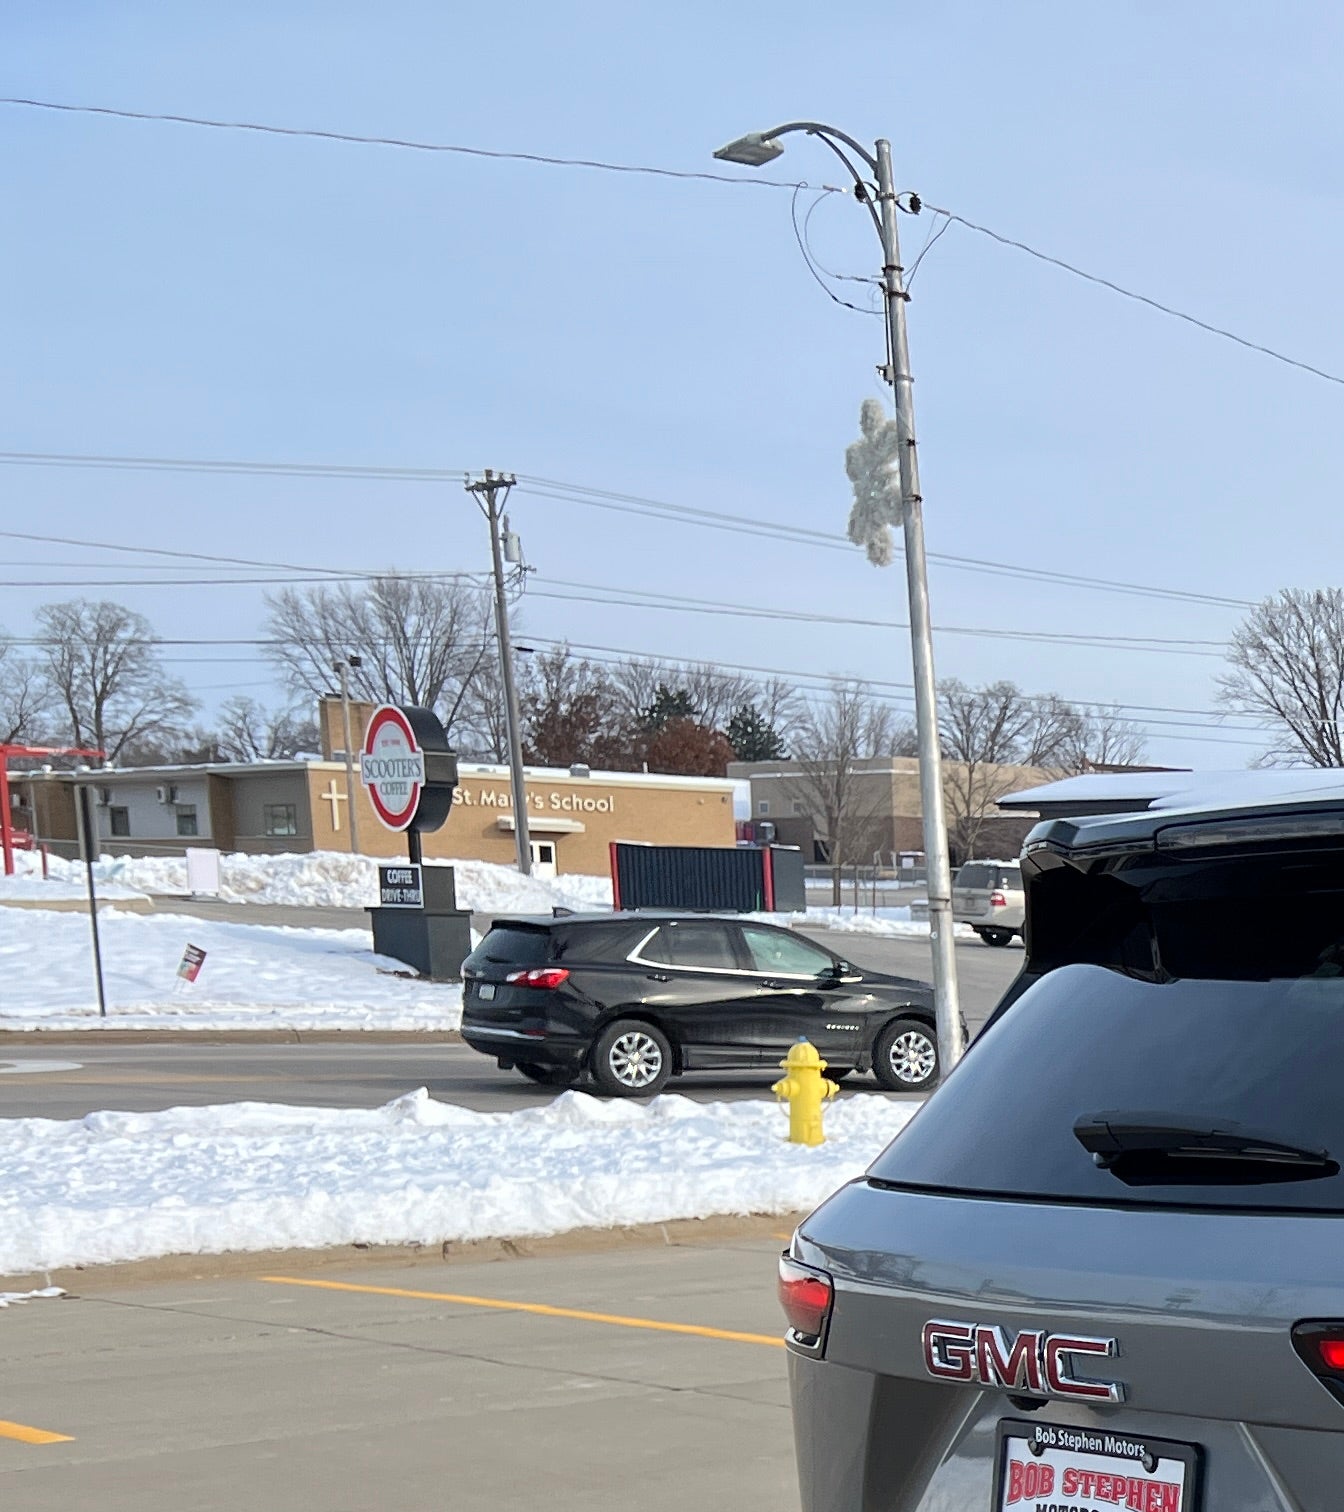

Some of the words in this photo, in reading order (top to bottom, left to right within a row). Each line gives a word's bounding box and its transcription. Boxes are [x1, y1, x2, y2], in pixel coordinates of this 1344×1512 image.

[380, 781, 408, 796] COFFEE
[452, 787, 478, 805] St.
[481, 789, 544, 810] Ma's
[551, 792, 614, 812] School
[386, 869, 413, 884] COFFEE
[921, 1318, 1127, 1403] GMC
[1035, 1426, 1057, 1446] Bob
[1057, 1430, 1102, 1453] Stephen
[1104, 1436, 1145, 1458] Motors
[1006, 1459, 1055, 1507] BOB
